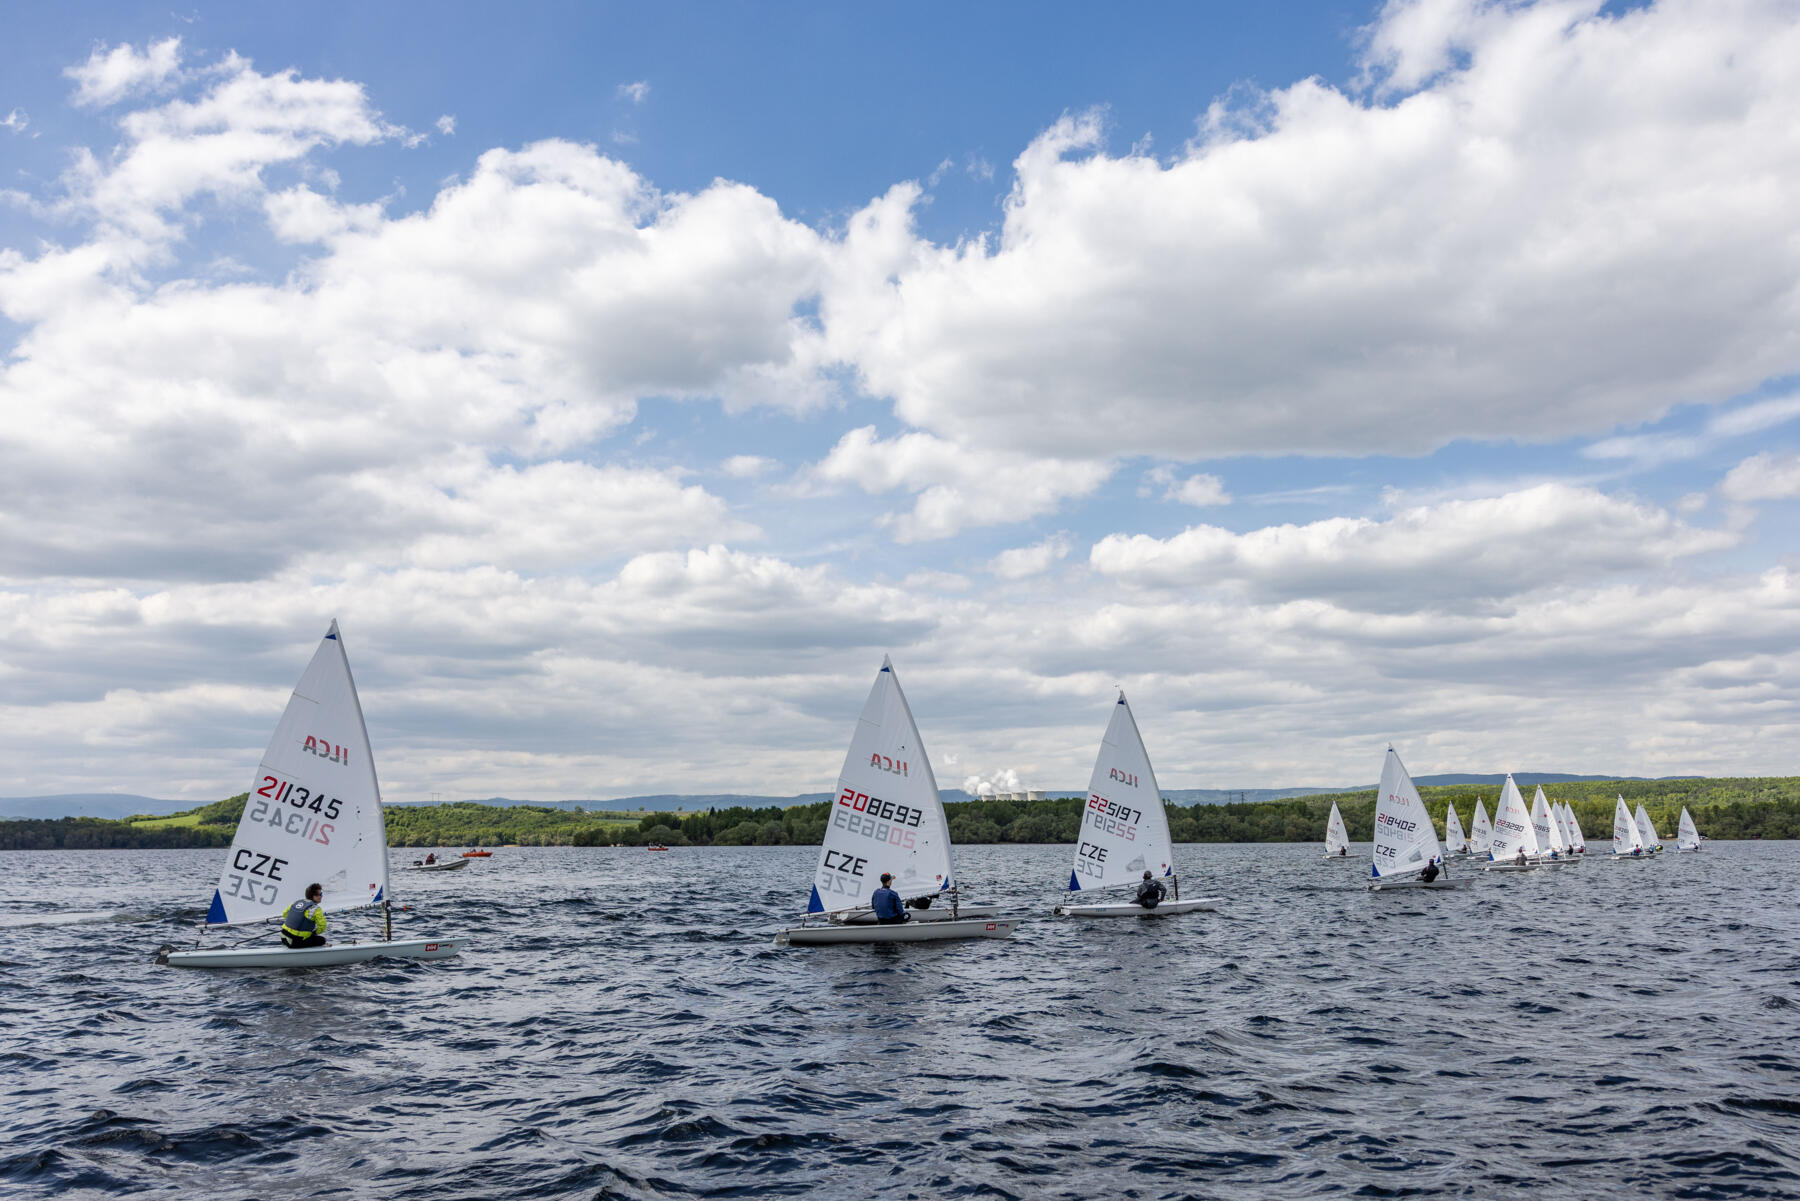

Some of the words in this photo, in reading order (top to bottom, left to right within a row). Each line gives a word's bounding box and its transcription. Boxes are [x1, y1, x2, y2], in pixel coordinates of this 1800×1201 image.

[257, 775, 343, 820] 211345
[839, 788, 922, 827] 208693
[1088, 794, 1141, 824] 225197
[1378, 813, 1416, 832] 218402
[824, 850, 868, 876] CZE
[1079, 842, 1108, 862] CZE
[1376, 844, 1396, 857] CZE
[233, 849, 288, 881] CZE
